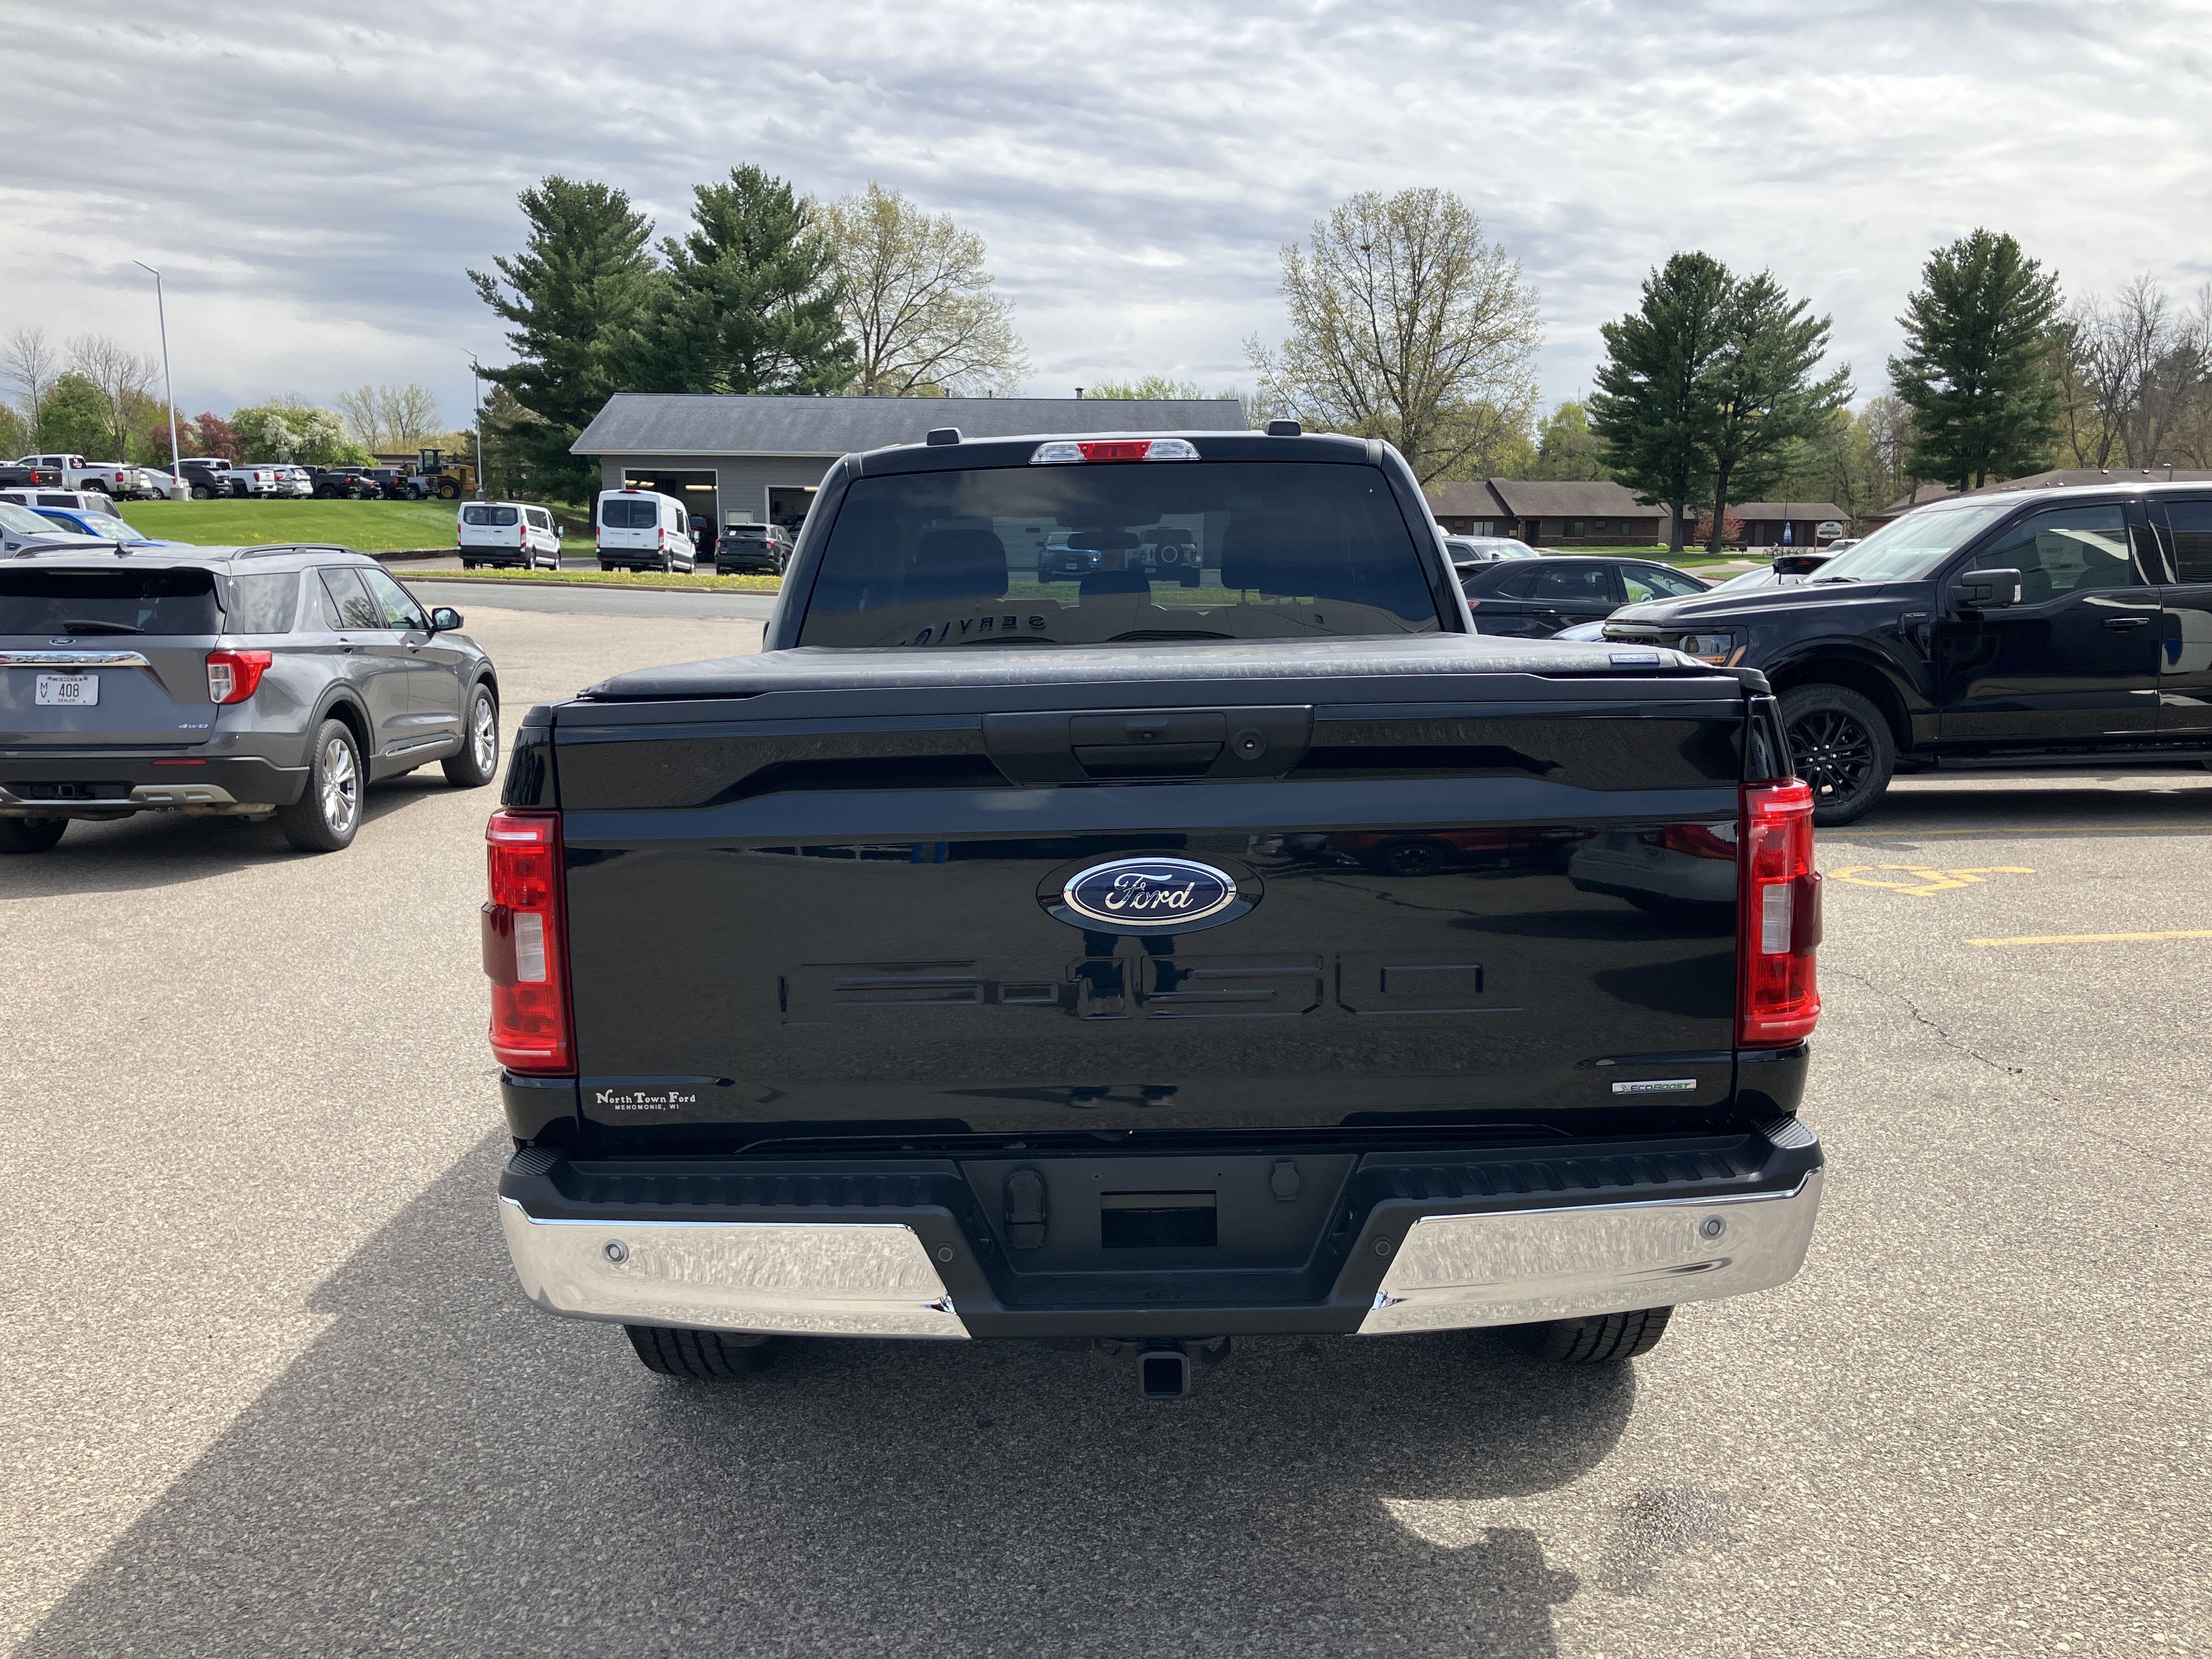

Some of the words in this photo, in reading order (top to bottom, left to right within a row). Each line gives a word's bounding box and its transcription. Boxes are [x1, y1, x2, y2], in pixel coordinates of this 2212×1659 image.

[59, 684, 79, 697] 408
[1105, 873, 1195, 910] Ford
[596, 1088, 633, 1104] North
[634, 1092, 667, 1103] Town
[668, 1091, 696, 1103] Ford
